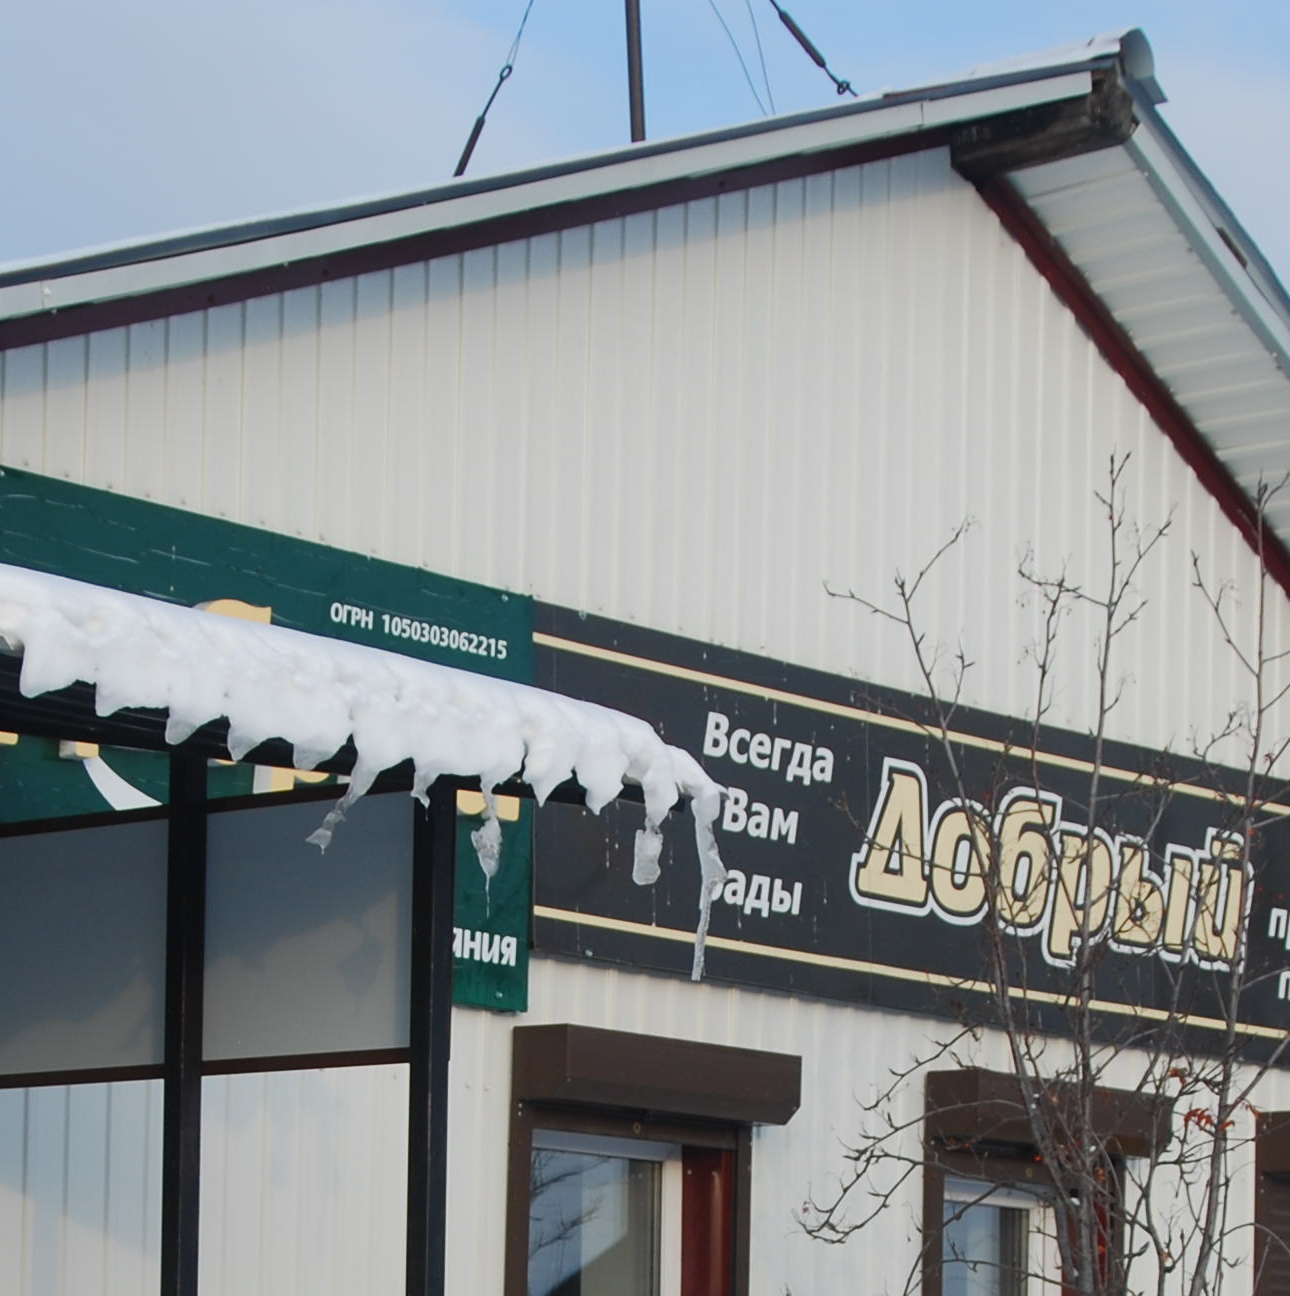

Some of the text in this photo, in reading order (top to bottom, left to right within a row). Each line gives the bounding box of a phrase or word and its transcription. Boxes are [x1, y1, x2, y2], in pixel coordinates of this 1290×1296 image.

[330, 602, 508, 660] ОГРН 1050303062215
[703, 711, 835, 786] Всегда
[722, 787, 799, 844] Вам
[849, 757, 1256, 974] Добрый
